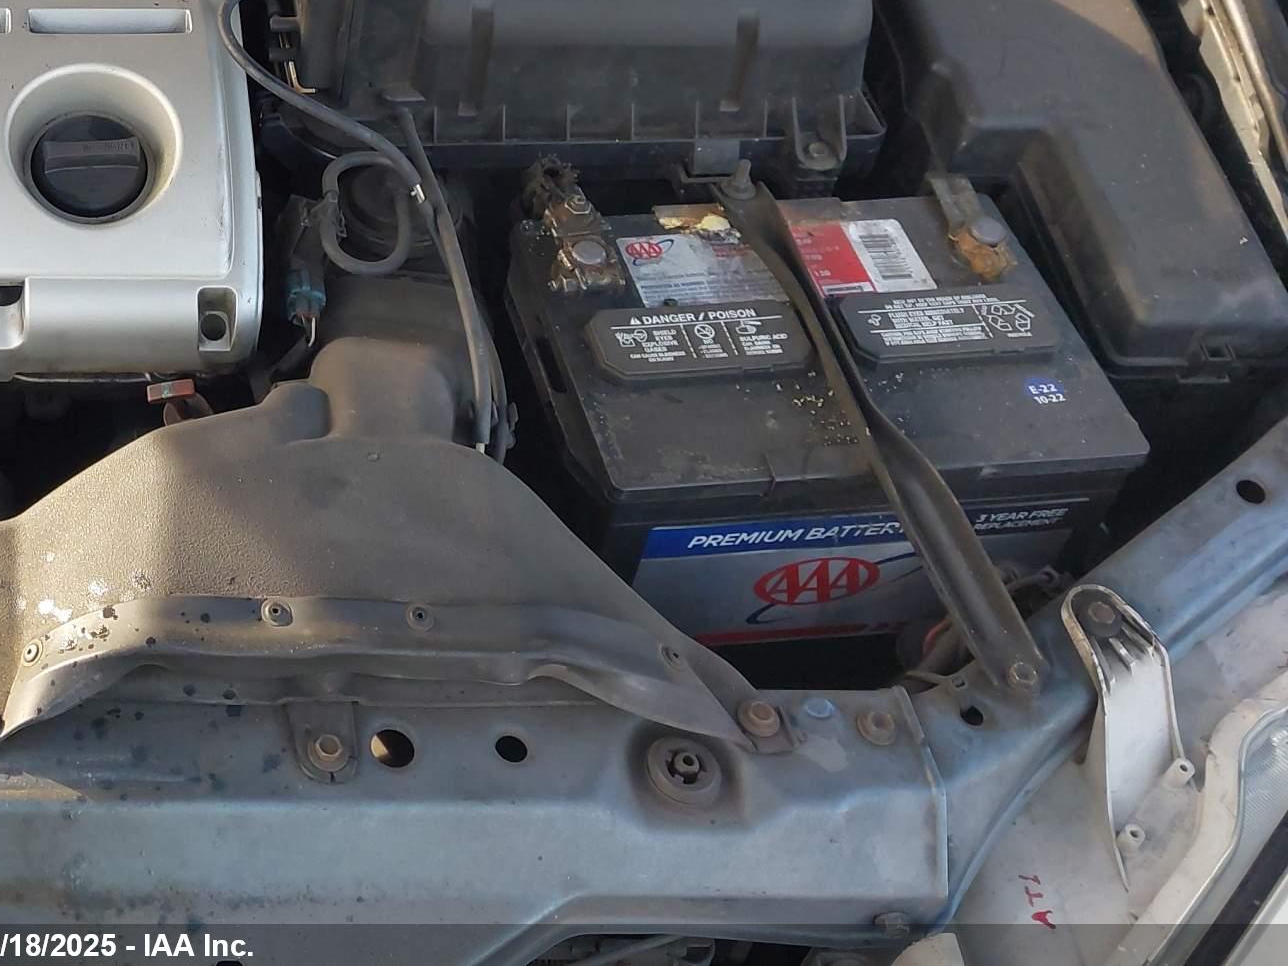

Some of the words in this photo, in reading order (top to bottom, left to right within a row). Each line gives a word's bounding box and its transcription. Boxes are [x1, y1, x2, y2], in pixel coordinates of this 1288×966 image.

[628, 241, 661, 259] AAA
[642, 313, 696, 325] DANGER
[708, 308, 757, 320] POISON
[1028, 383, 1058, 395] E-22
[1033, 393, 1067, 405] 10-22
[989, 511, 1029, 522] YEAR
[1028, 508, 1069, 519] FREE
[686, 528, 804, 549] PREMIUM
[804, 522, 904, 542] BATTER
[759, 557, 875, 605] AAA
